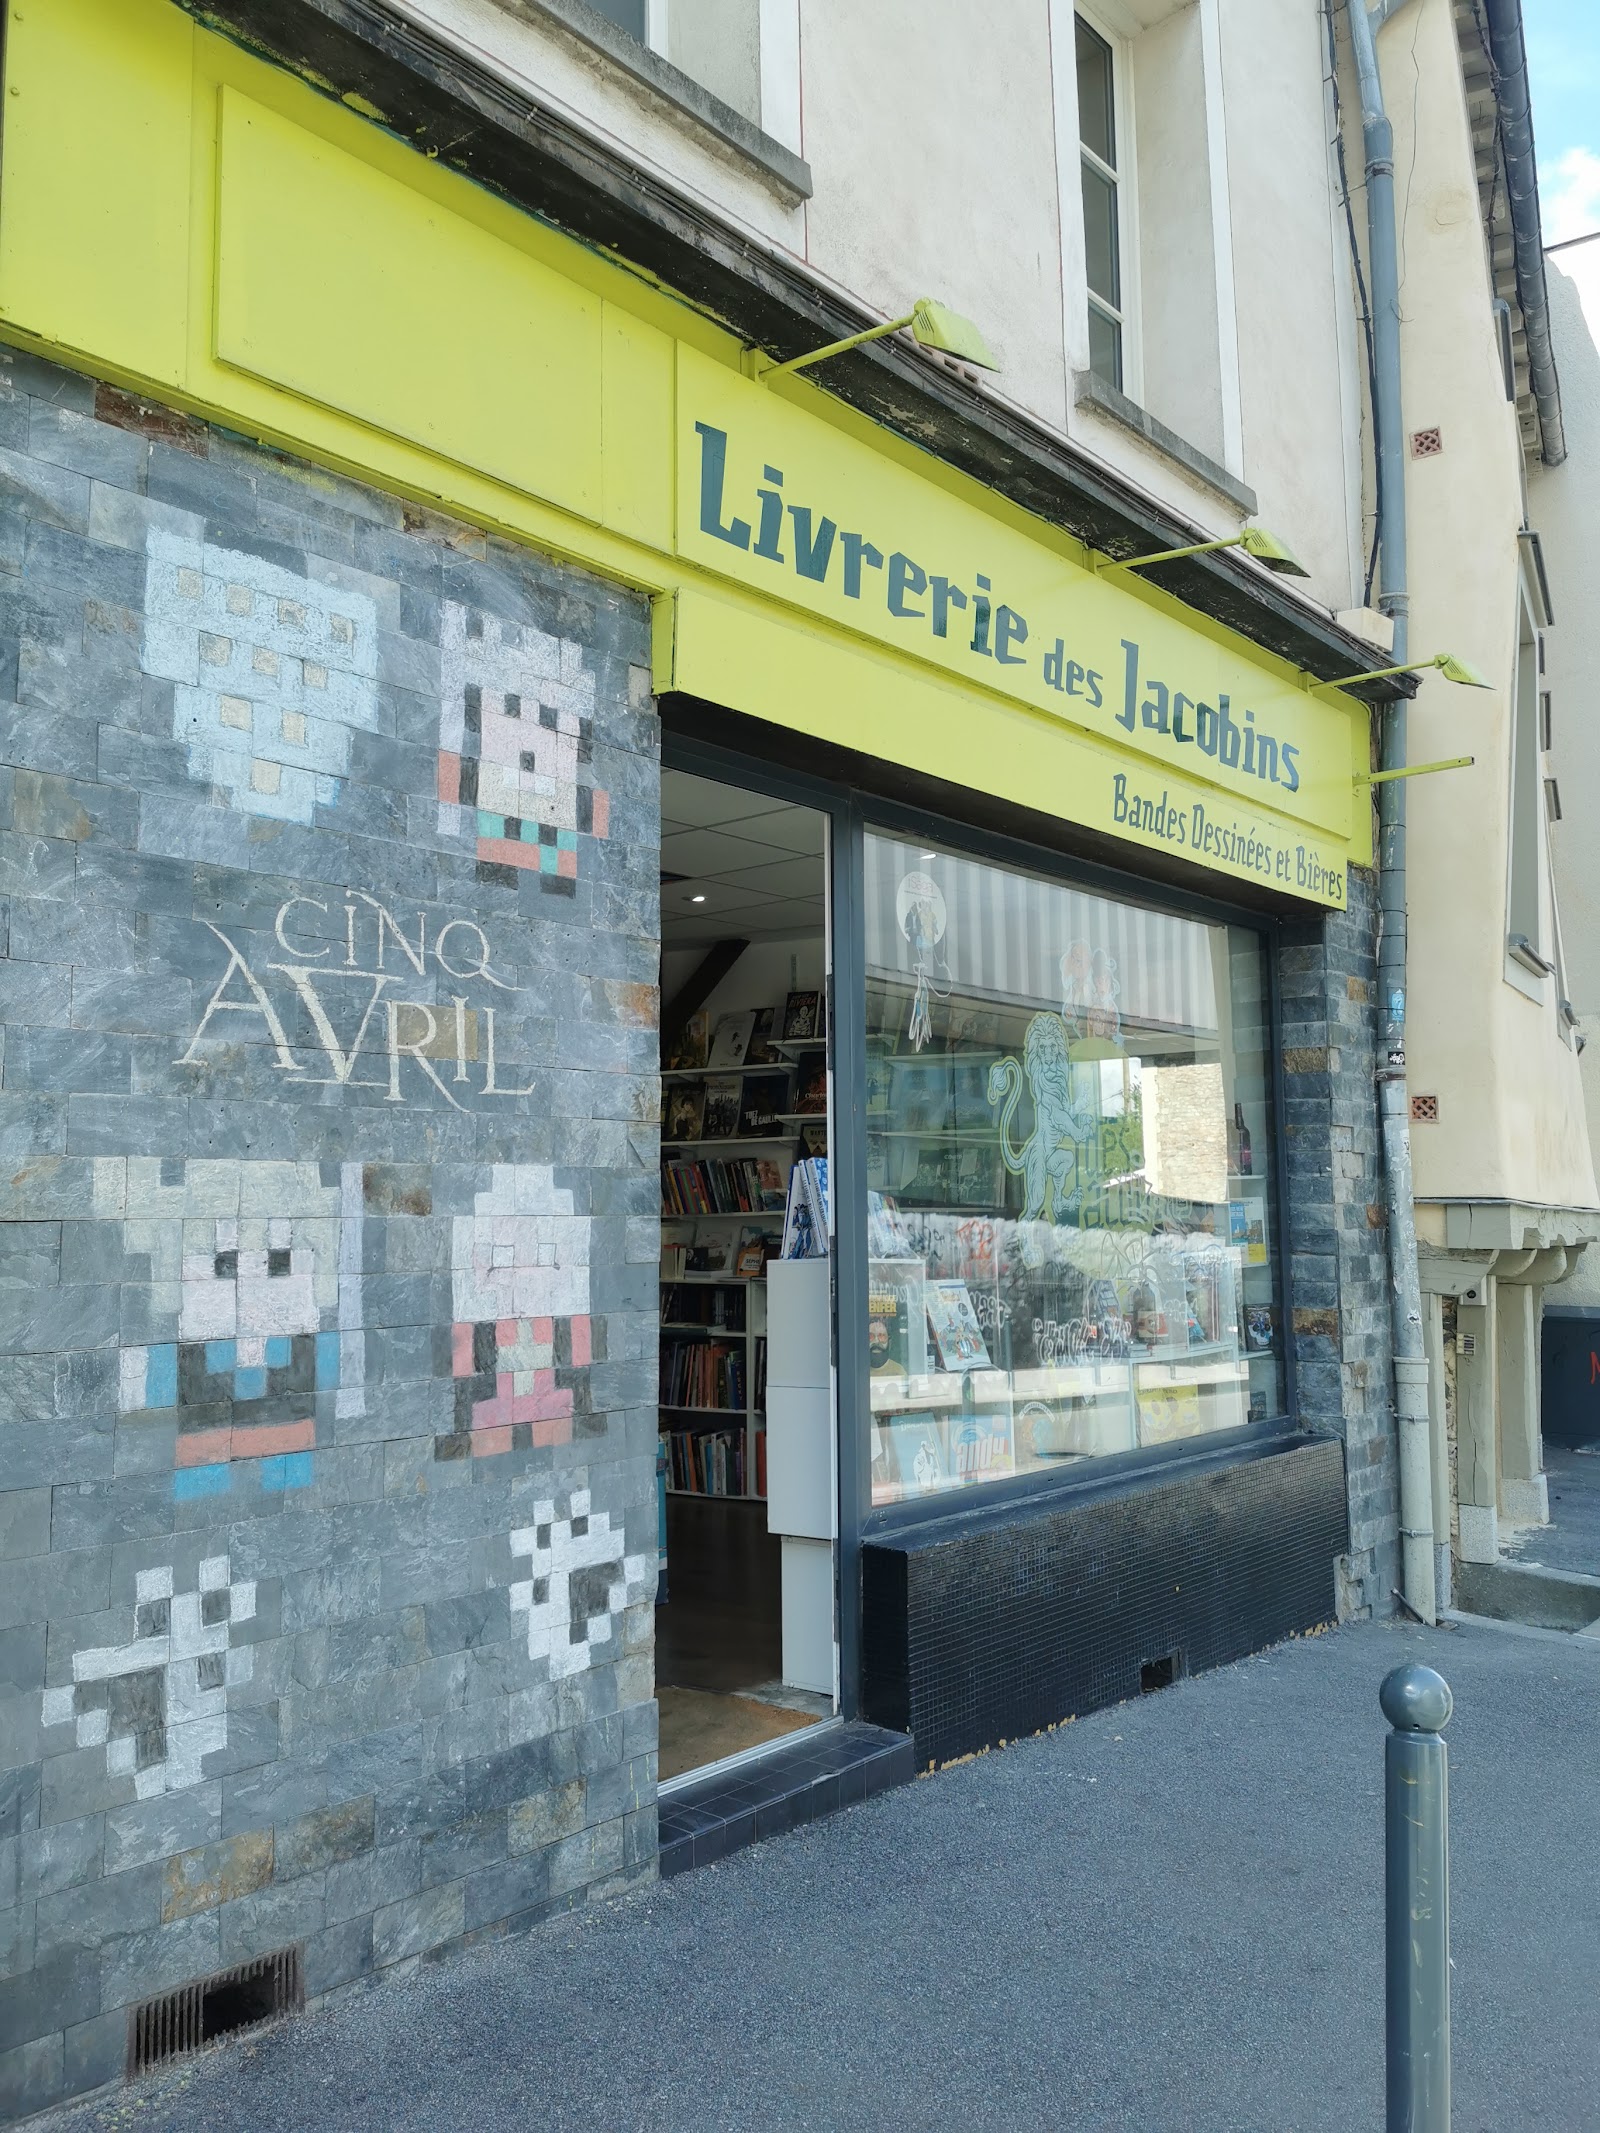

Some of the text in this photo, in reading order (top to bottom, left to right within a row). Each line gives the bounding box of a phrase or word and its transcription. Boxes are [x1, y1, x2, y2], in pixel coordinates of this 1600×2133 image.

[694, 420, 1301, 794] Livrerie des Jacobins
[1113, 773, 1344, 901] Bandes Dessinées et Bières
[171, 920, 537, 1113] AVRIL
[274, 889, 527, 991] CINQ
